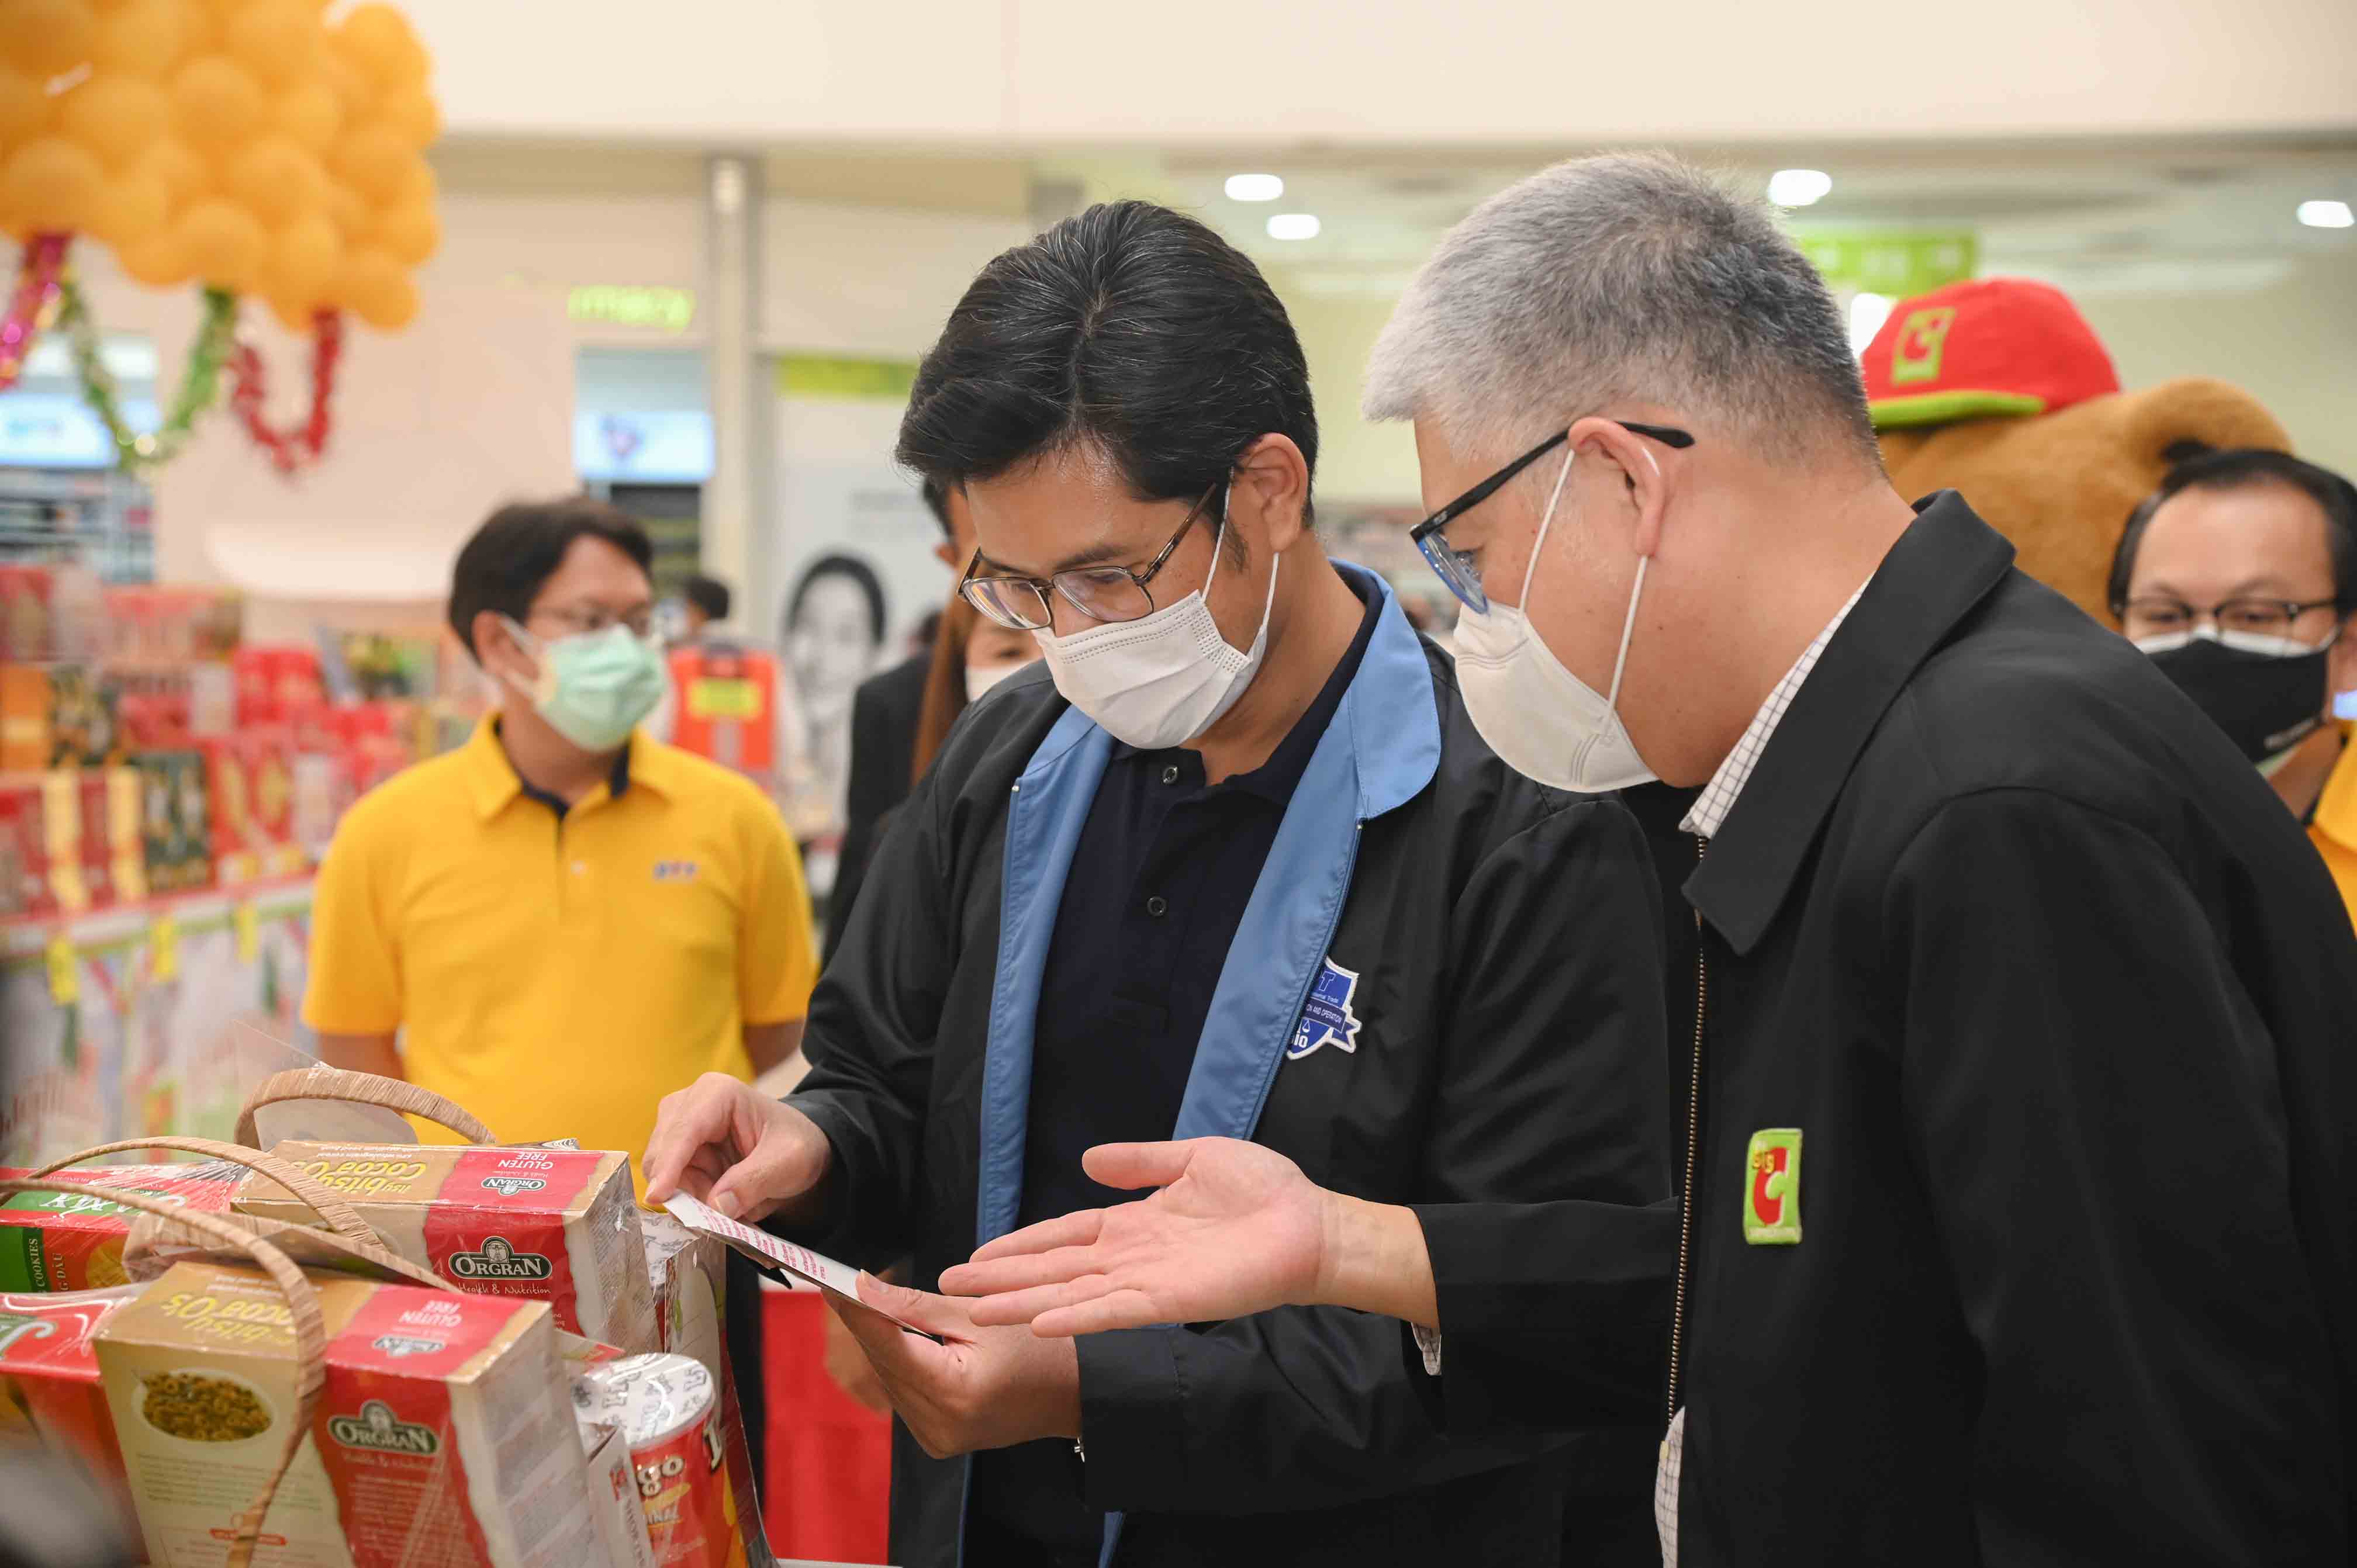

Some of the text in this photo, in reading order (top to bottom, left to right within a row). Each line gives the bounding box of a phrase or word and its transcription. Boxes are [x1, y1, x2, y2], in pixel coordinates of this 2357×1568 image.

[1321, 1008, 1343, 1023] OPERATION
[515, 1152, 548, 1160] FREE
[336, 1161, 427, 1180] Cocoa
[497, 1159, 554, 1169] GLUTEN
[28, 1238, 46, 1287] COOKIES
[458, 1281, 552, 1295] Health & Nutrition
